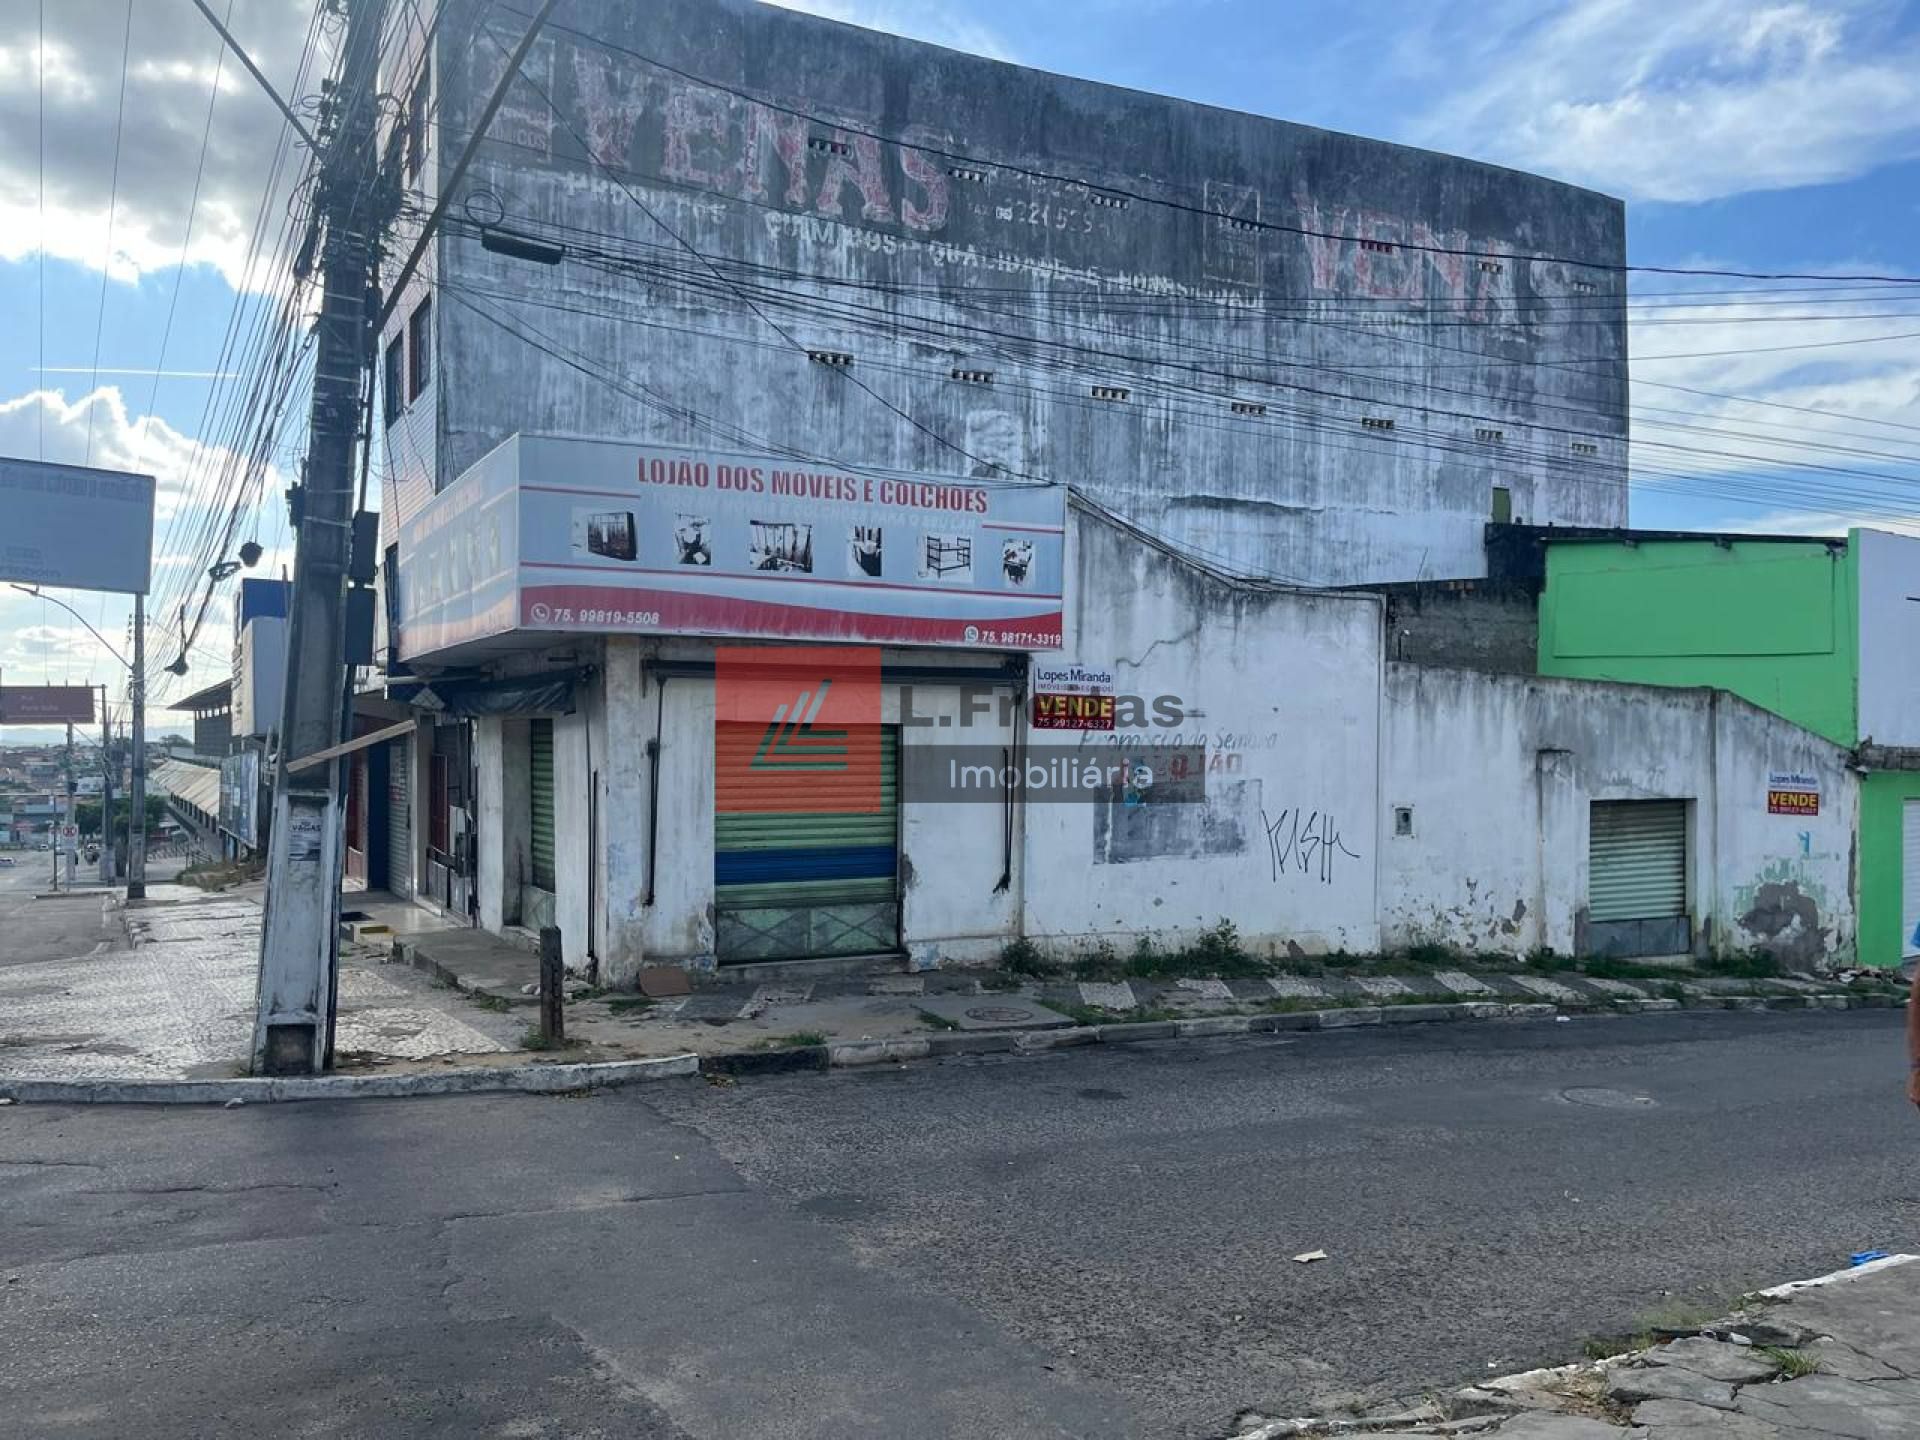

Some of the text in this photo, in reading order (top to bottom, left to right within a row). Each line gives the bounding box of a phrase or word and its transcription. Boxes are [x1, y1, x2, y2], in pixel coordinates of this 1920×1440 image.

[638, 455, 709, 488] LOJÃO
[716, 464, 765, 494] DOS
[771, 468, 858, 502] MÓVEIS
[864, 478, 873, 503] E
[553, 608, 660, 625] 75. 99819-5508
[1001, 631, 1061, 646] 98171-3319
[1037, 667, 1111, 684] Lopes Miranda
[1038, 694, 1113, 719] VENDE
[1770, 792, 1818, 808] VENDE
